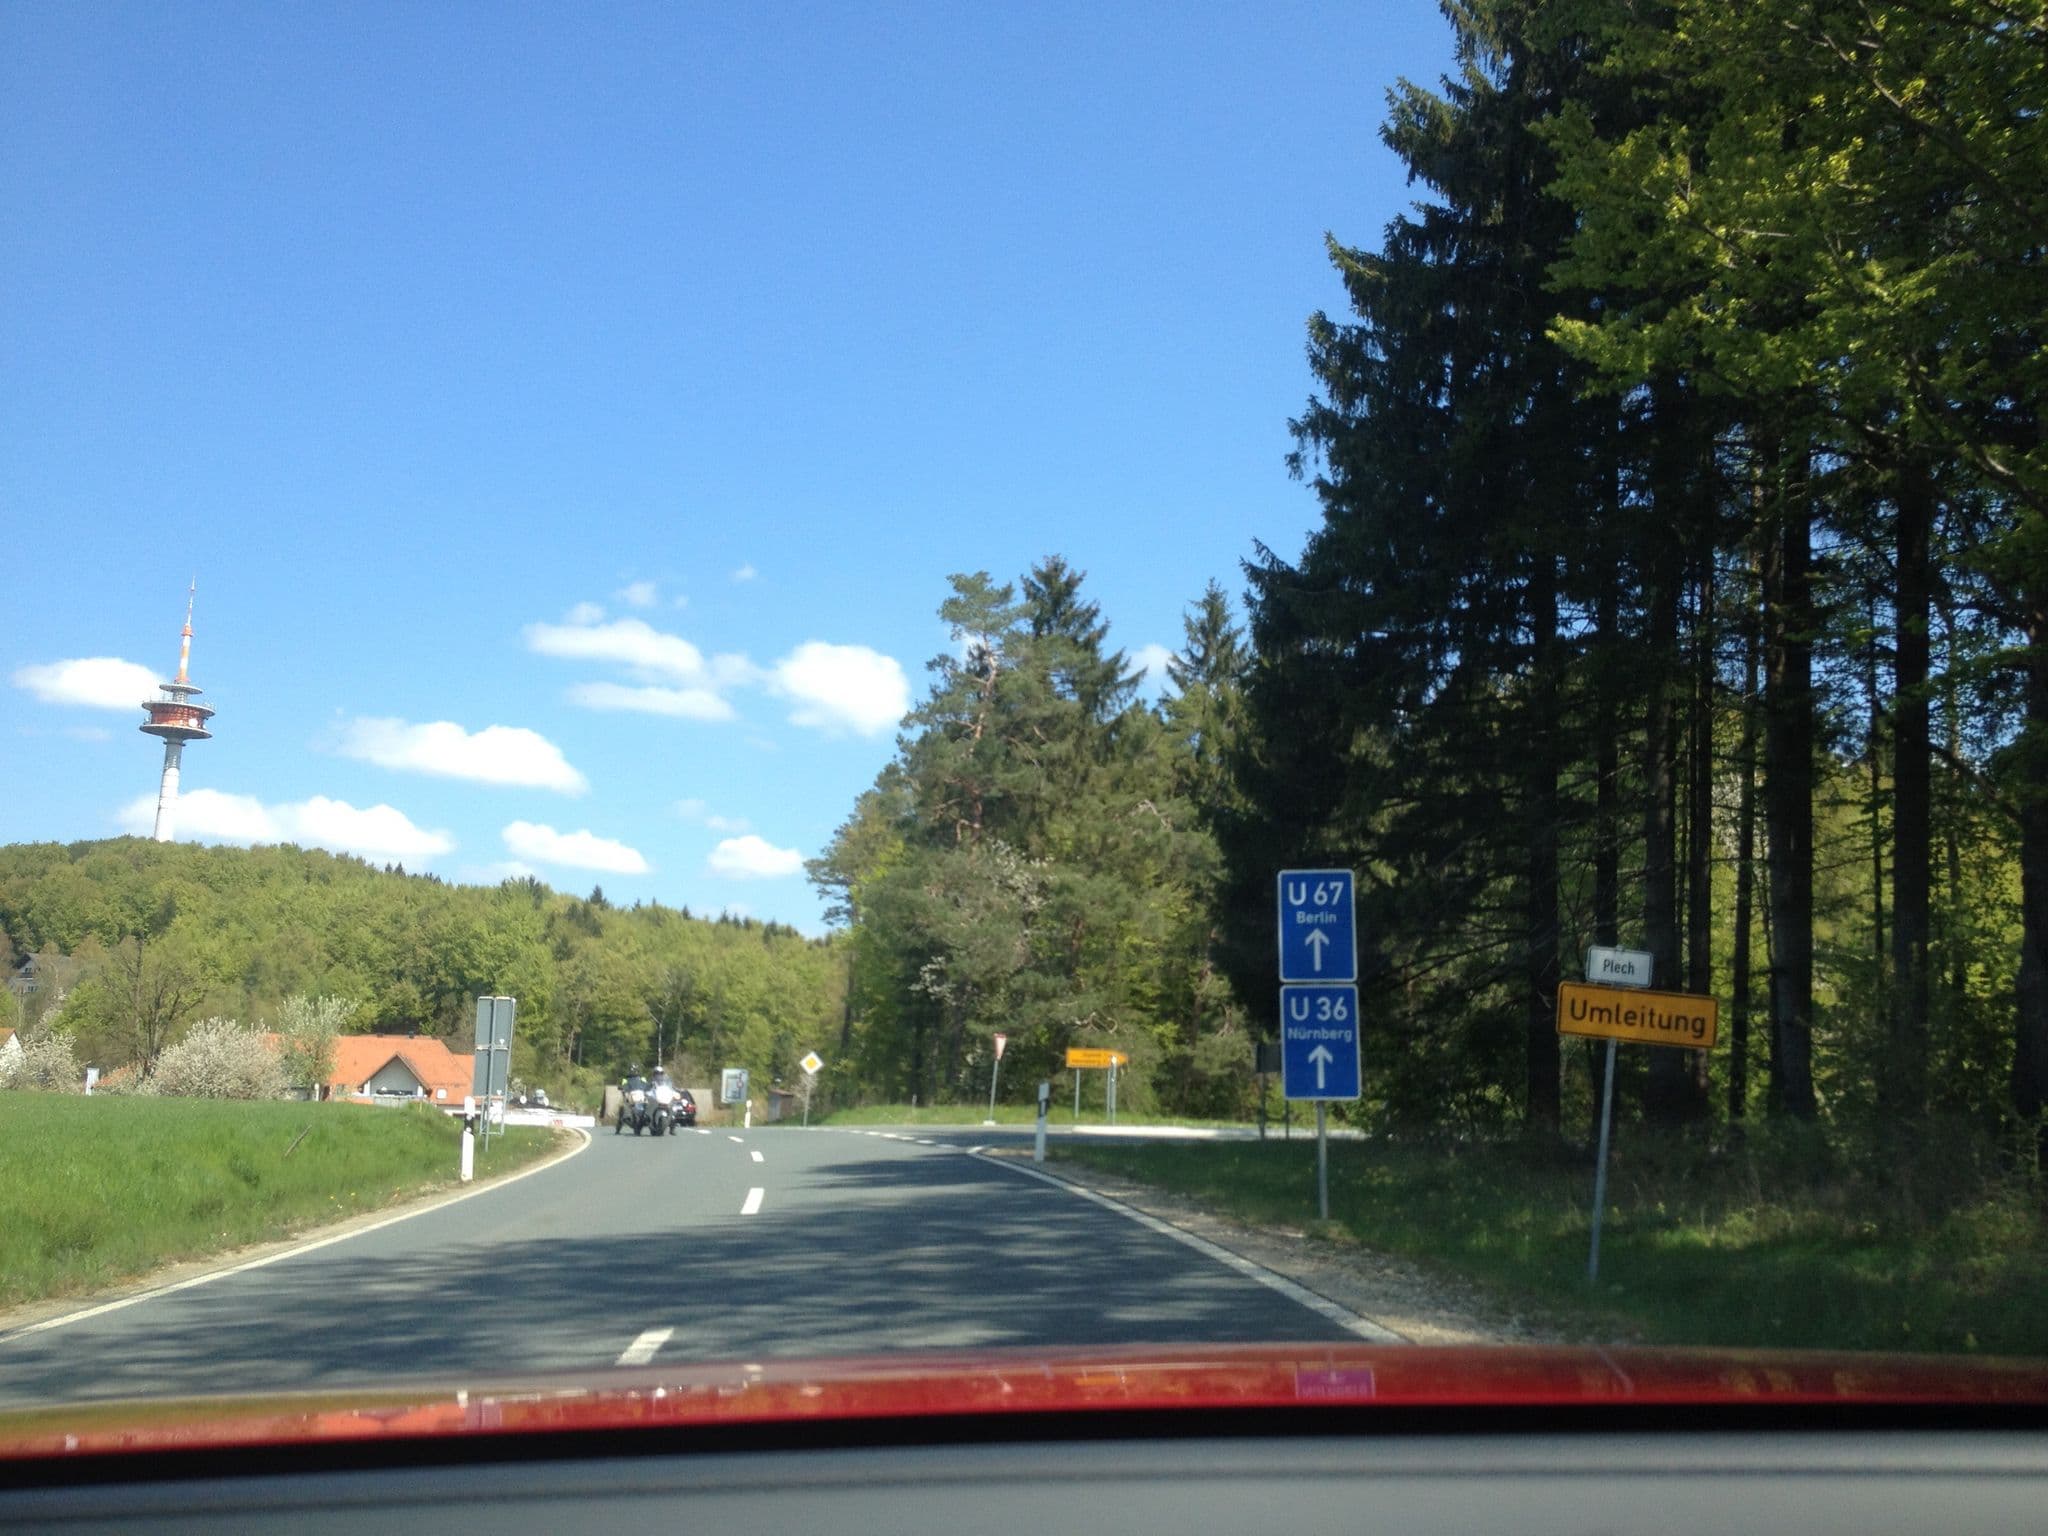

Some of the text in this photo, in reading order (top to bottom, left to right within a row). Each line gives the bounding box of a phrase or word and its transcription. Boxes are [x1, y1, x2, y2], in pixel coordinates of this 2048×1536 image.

[1296, 911, 1336, 924] Berlin
[1603, 959, 1635, 976] Plech
[1570, 998, 1706, 1039] Umleitung
[1288, 1027, 1352, 1043] Nürnberg
